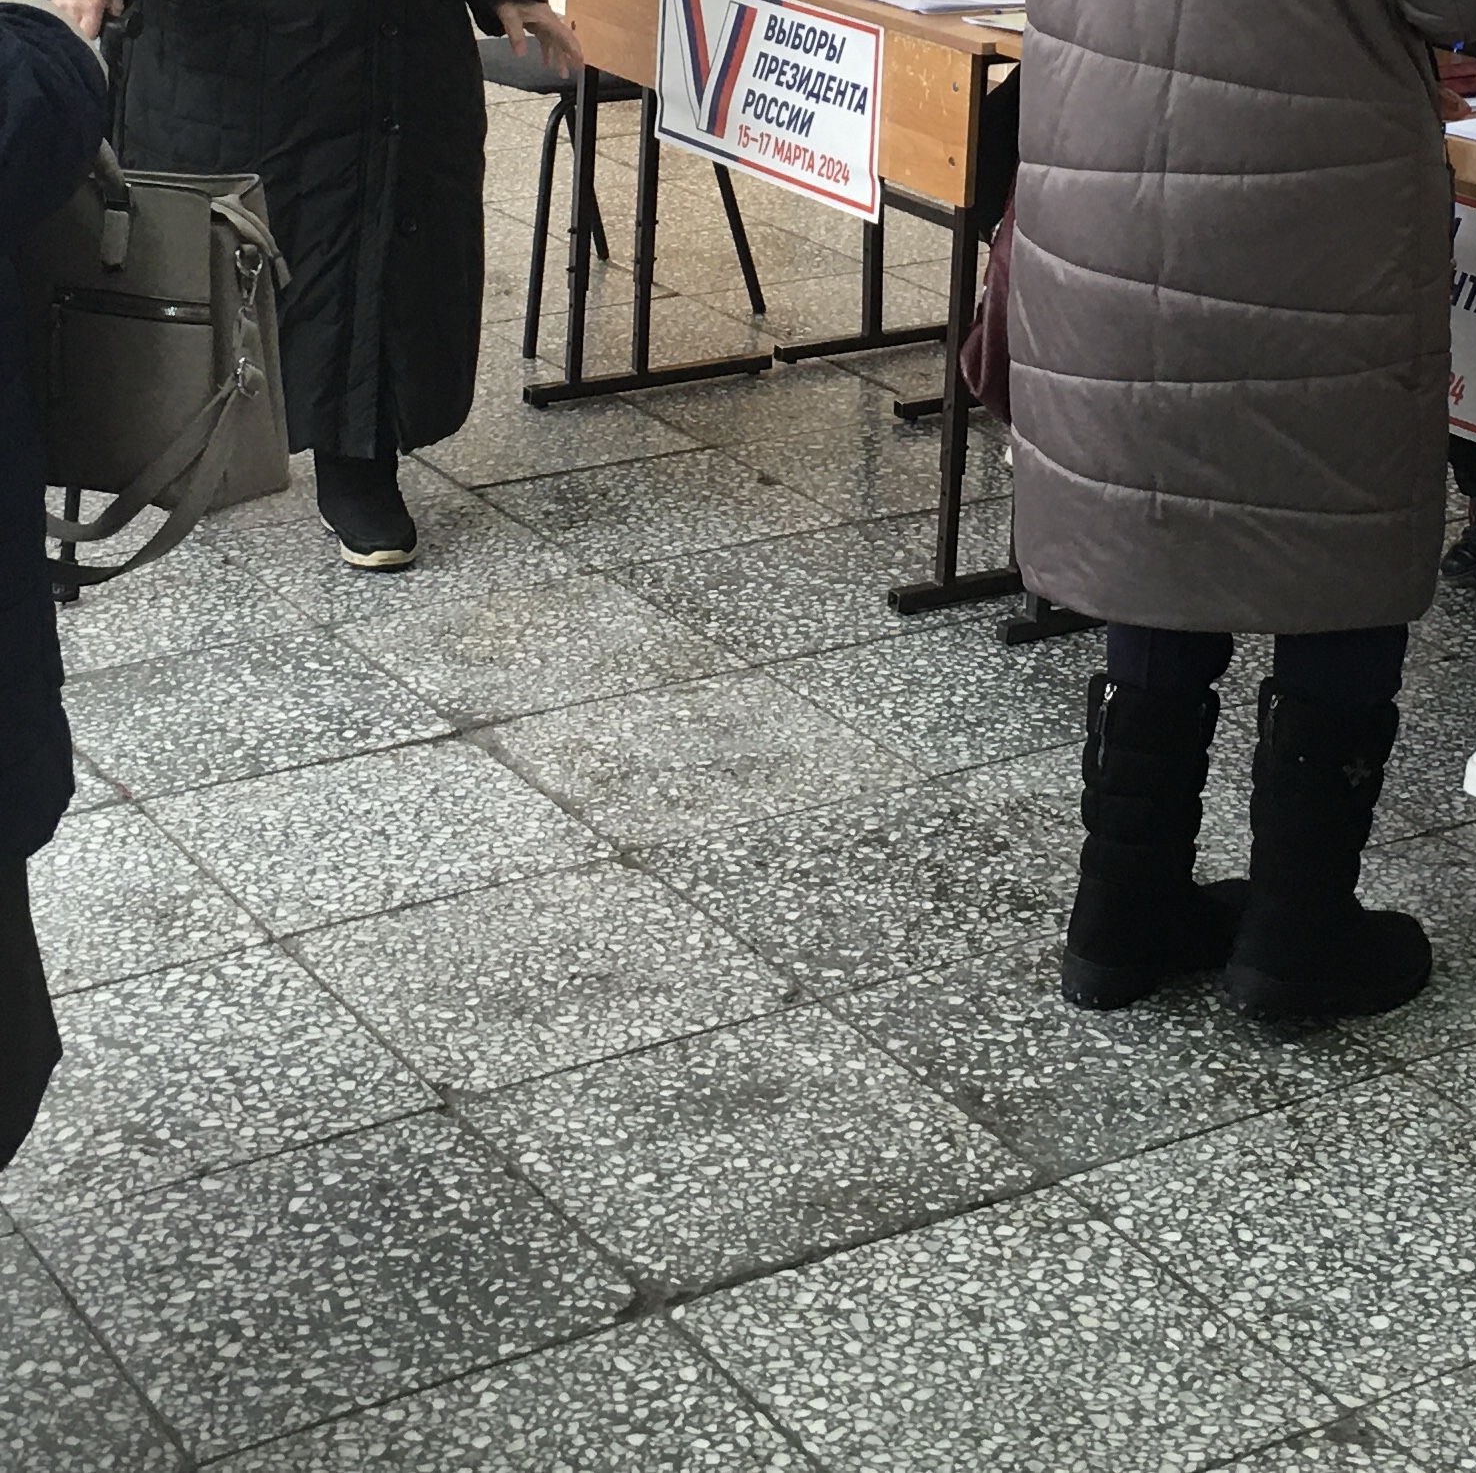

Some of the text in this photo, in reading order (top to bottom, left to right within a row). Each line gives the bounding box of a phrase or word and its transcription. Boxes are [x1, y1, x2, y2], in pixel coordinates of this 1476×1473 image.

[763, 14, 847, 65] ВЫБОРЫ
[752, 52, 869, 115] ПРЕЗИДЕНТА
[741, 88, 815, 138] РОССИИ
[772, 137, 816, 174] МАРТА
[817, 154, 850, 186] 2024
